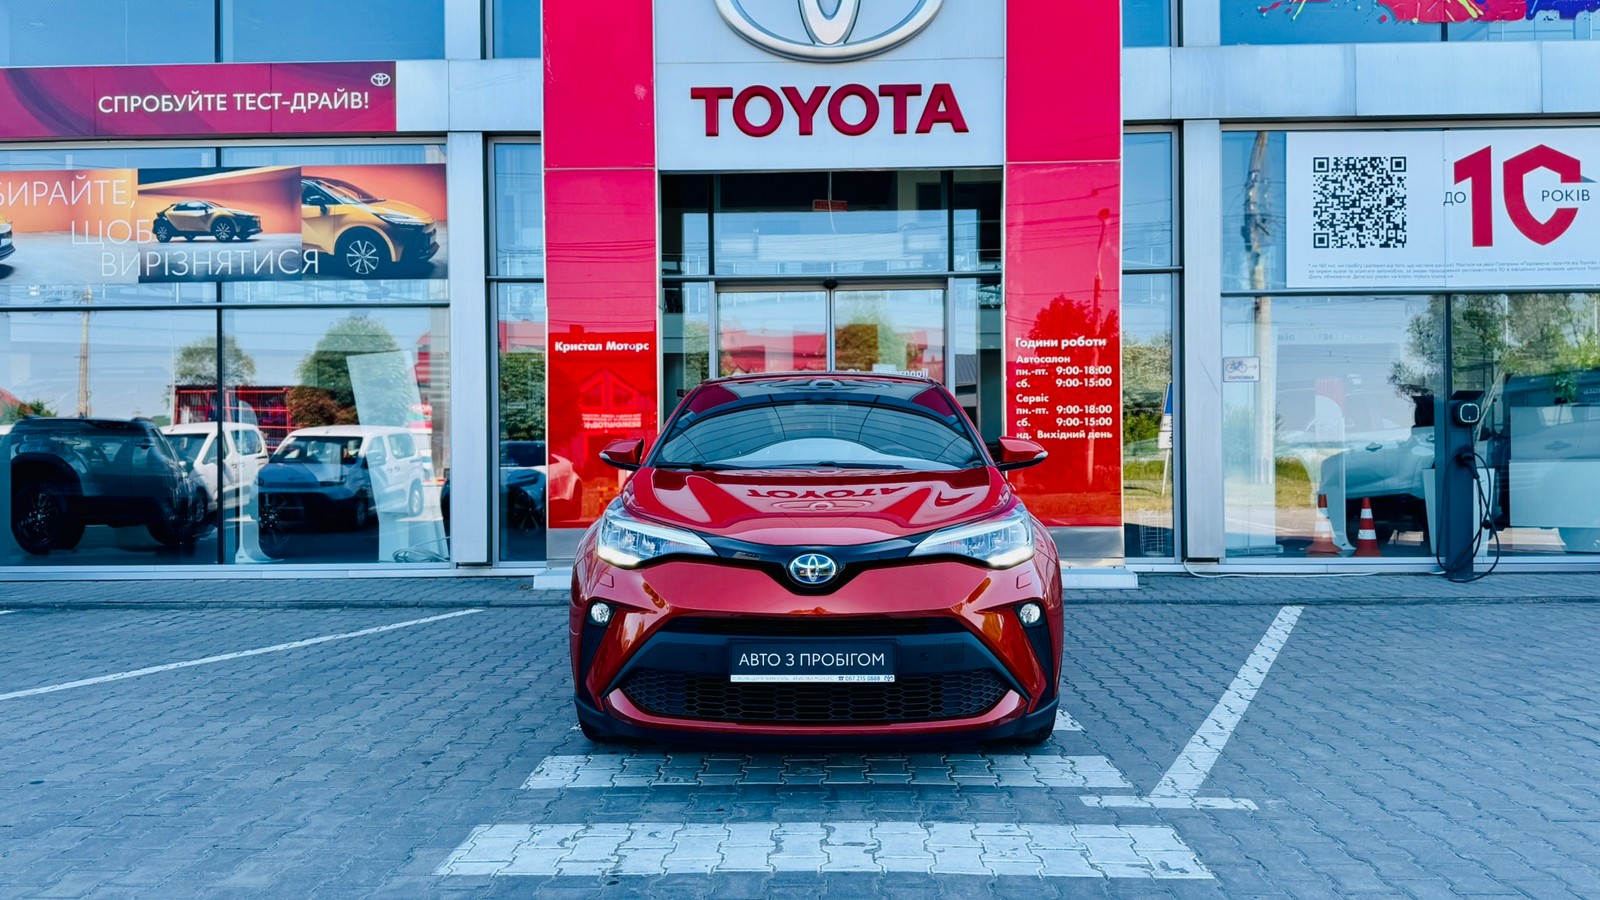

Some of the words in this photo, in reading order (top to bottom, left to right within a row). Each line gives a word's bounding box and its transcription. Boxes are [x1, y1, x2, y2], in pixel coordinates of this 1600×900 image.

[98, 90, 228, 113] СПРОБУЙТЕ
[233, 88, 370, 114] ТЕСТ-ДРАЙВ!
[690, 83, 969, 137] TOYOTA
[1443, 191, 1467, 206] ДО
[1541, 189, 1591, 202] РОКІВ
[71, 219, 153, 250] ЩОБ
[101, 248, 319, 277] ВИРІЗНЯТИСЯ
[554, 341, 602, 353] Кристал
[605, 341, 650, 352] Моторс
[1015, 337, 1058, 348] Години
[1061, 335, 1107, 350] роботи
[1016, 355, 1071, 363] Автосалон
[1015, 368, 1049, 376] пн.-пт.
[1015, 379, 1031, 388] сб.
[1016, 393, 1049, 405] Сервіс
[1016, 407, 1049, 415] пн.-пт.
[1016, 418, 1031, 427] сб.
[1016, 432, 1032, 440] нд.
[1037, 430, 1085, 440] Вихідний
[1088, 431, 1113, 439] день
[739, 652, 781, 667] АВТО
[785, 652, 795, 667] З
[800, 652, 886, 667] ПРОБІГОМ
